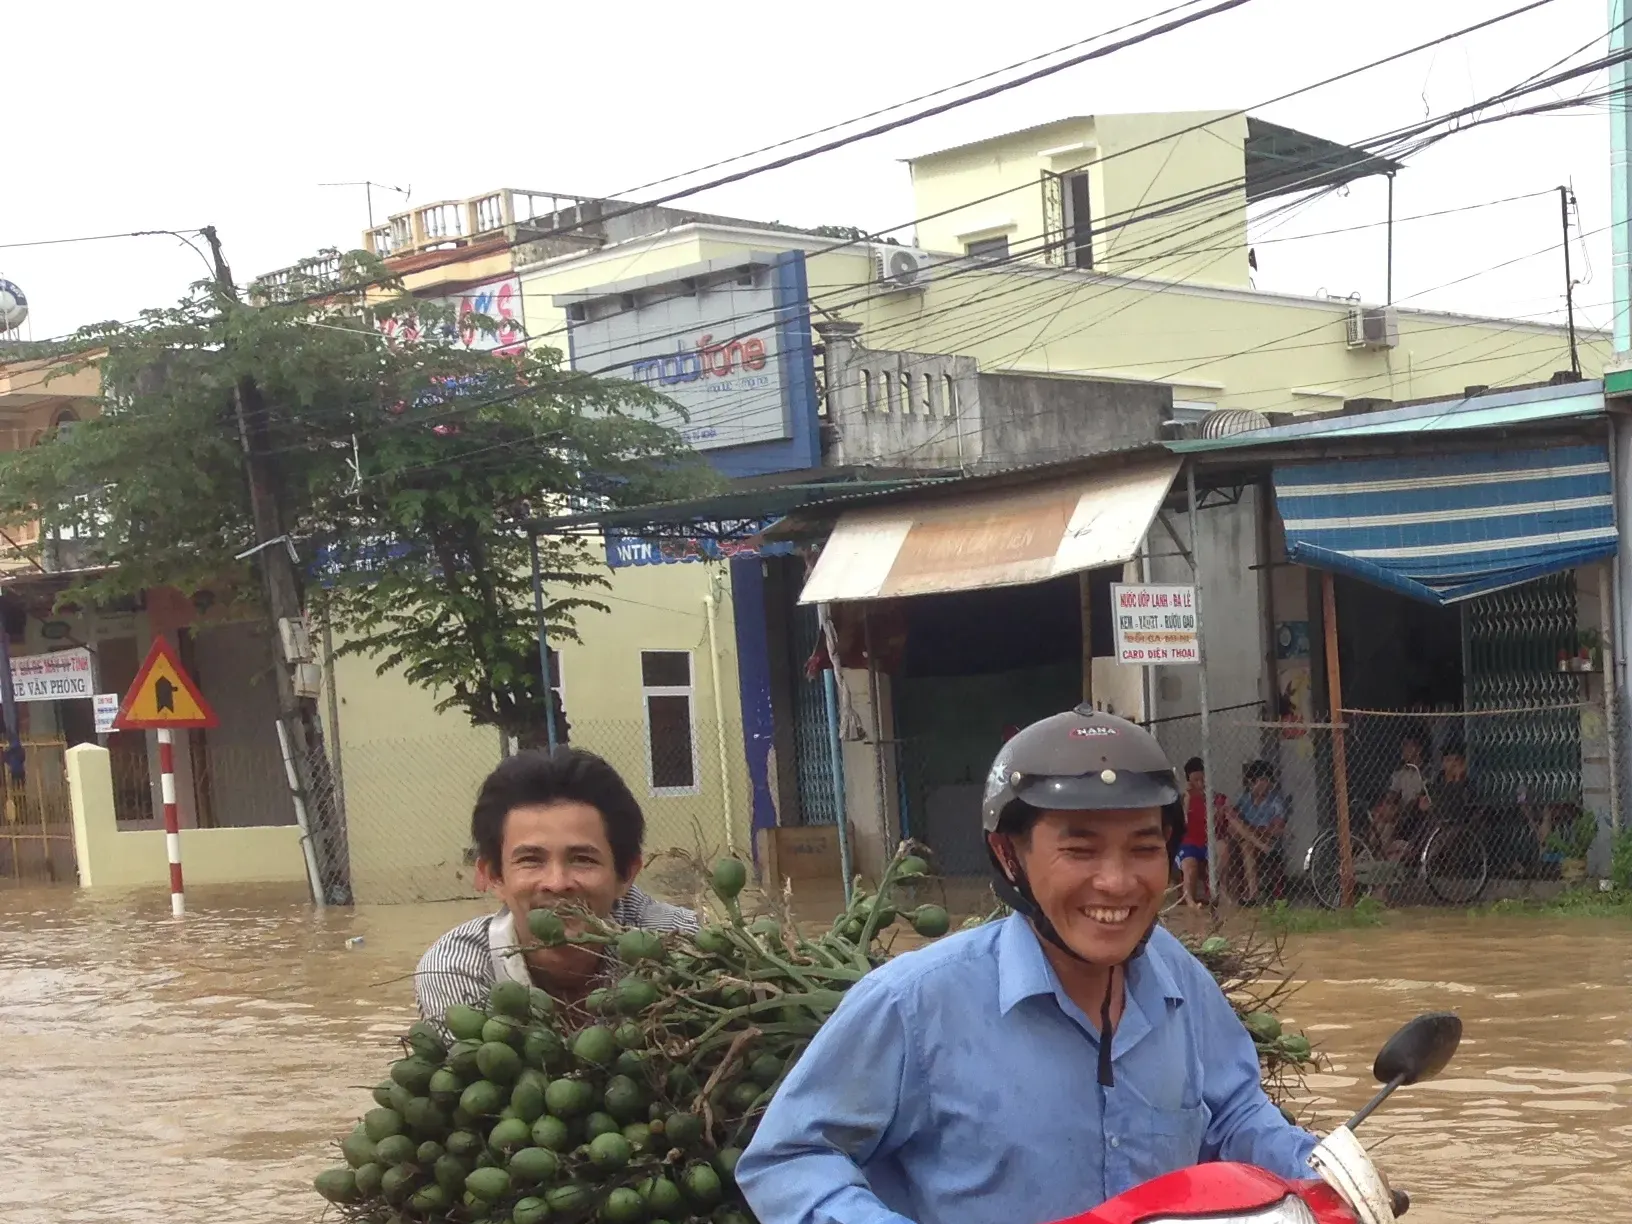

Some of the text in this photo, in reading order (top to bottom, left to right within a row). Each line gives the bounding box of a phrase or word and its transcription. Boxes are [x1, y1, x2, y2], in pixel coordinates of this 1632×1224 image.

[1120, 614, 1134, 630] KEM
[1122, 646, 1195, 661] CARD ĐIỆN THOẠI
[28, 677, 48, 696] VĂN
